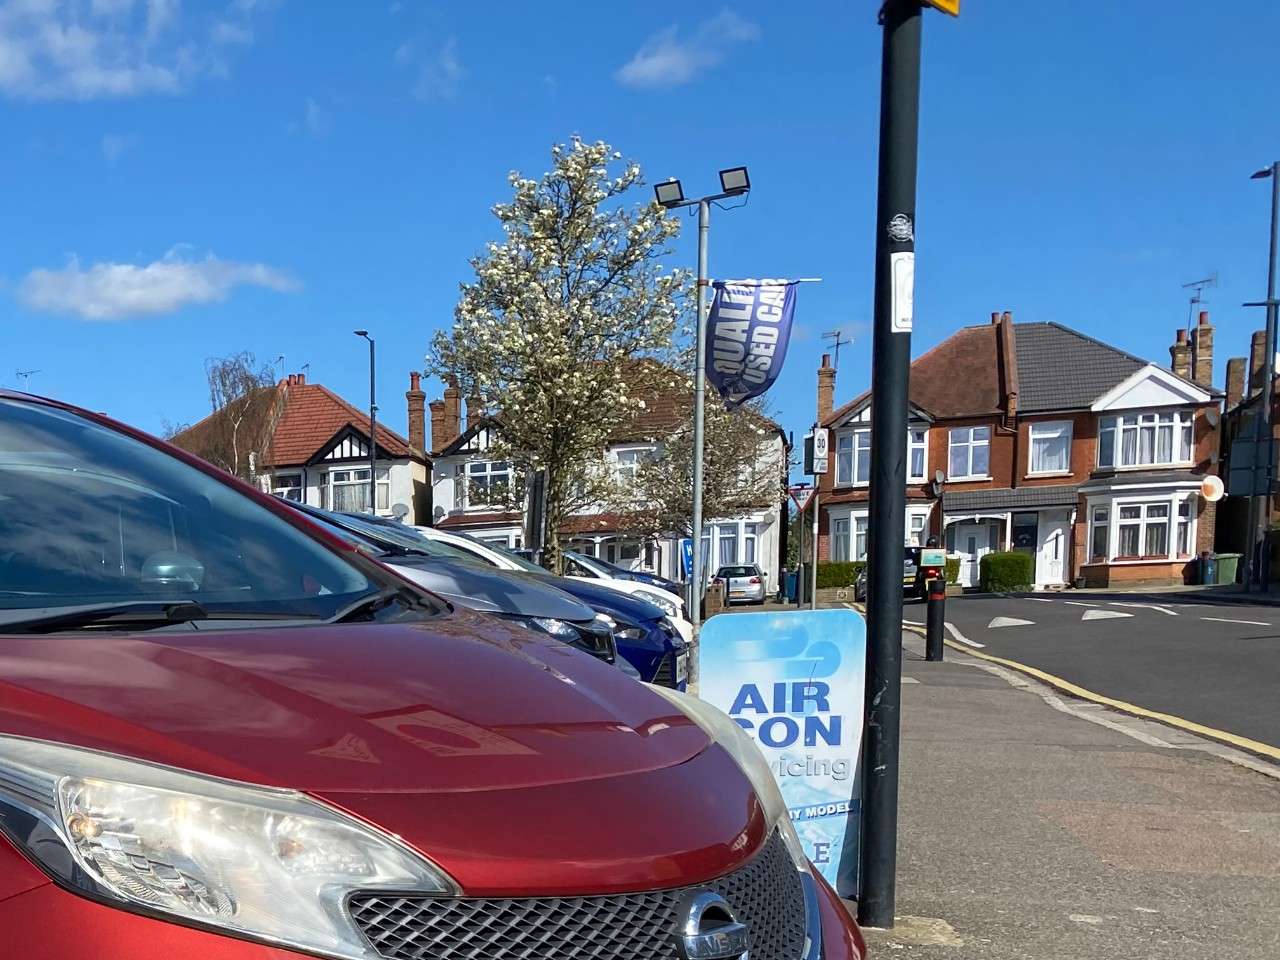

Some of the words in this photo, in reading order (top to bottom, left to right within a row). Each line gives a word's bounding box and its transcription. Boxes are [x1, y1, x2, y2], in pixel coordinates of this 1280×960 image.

[742, 326, 779, 384] USED
[817, 438, 826, 449] 30
[728, 681, 831, 714] AIR
